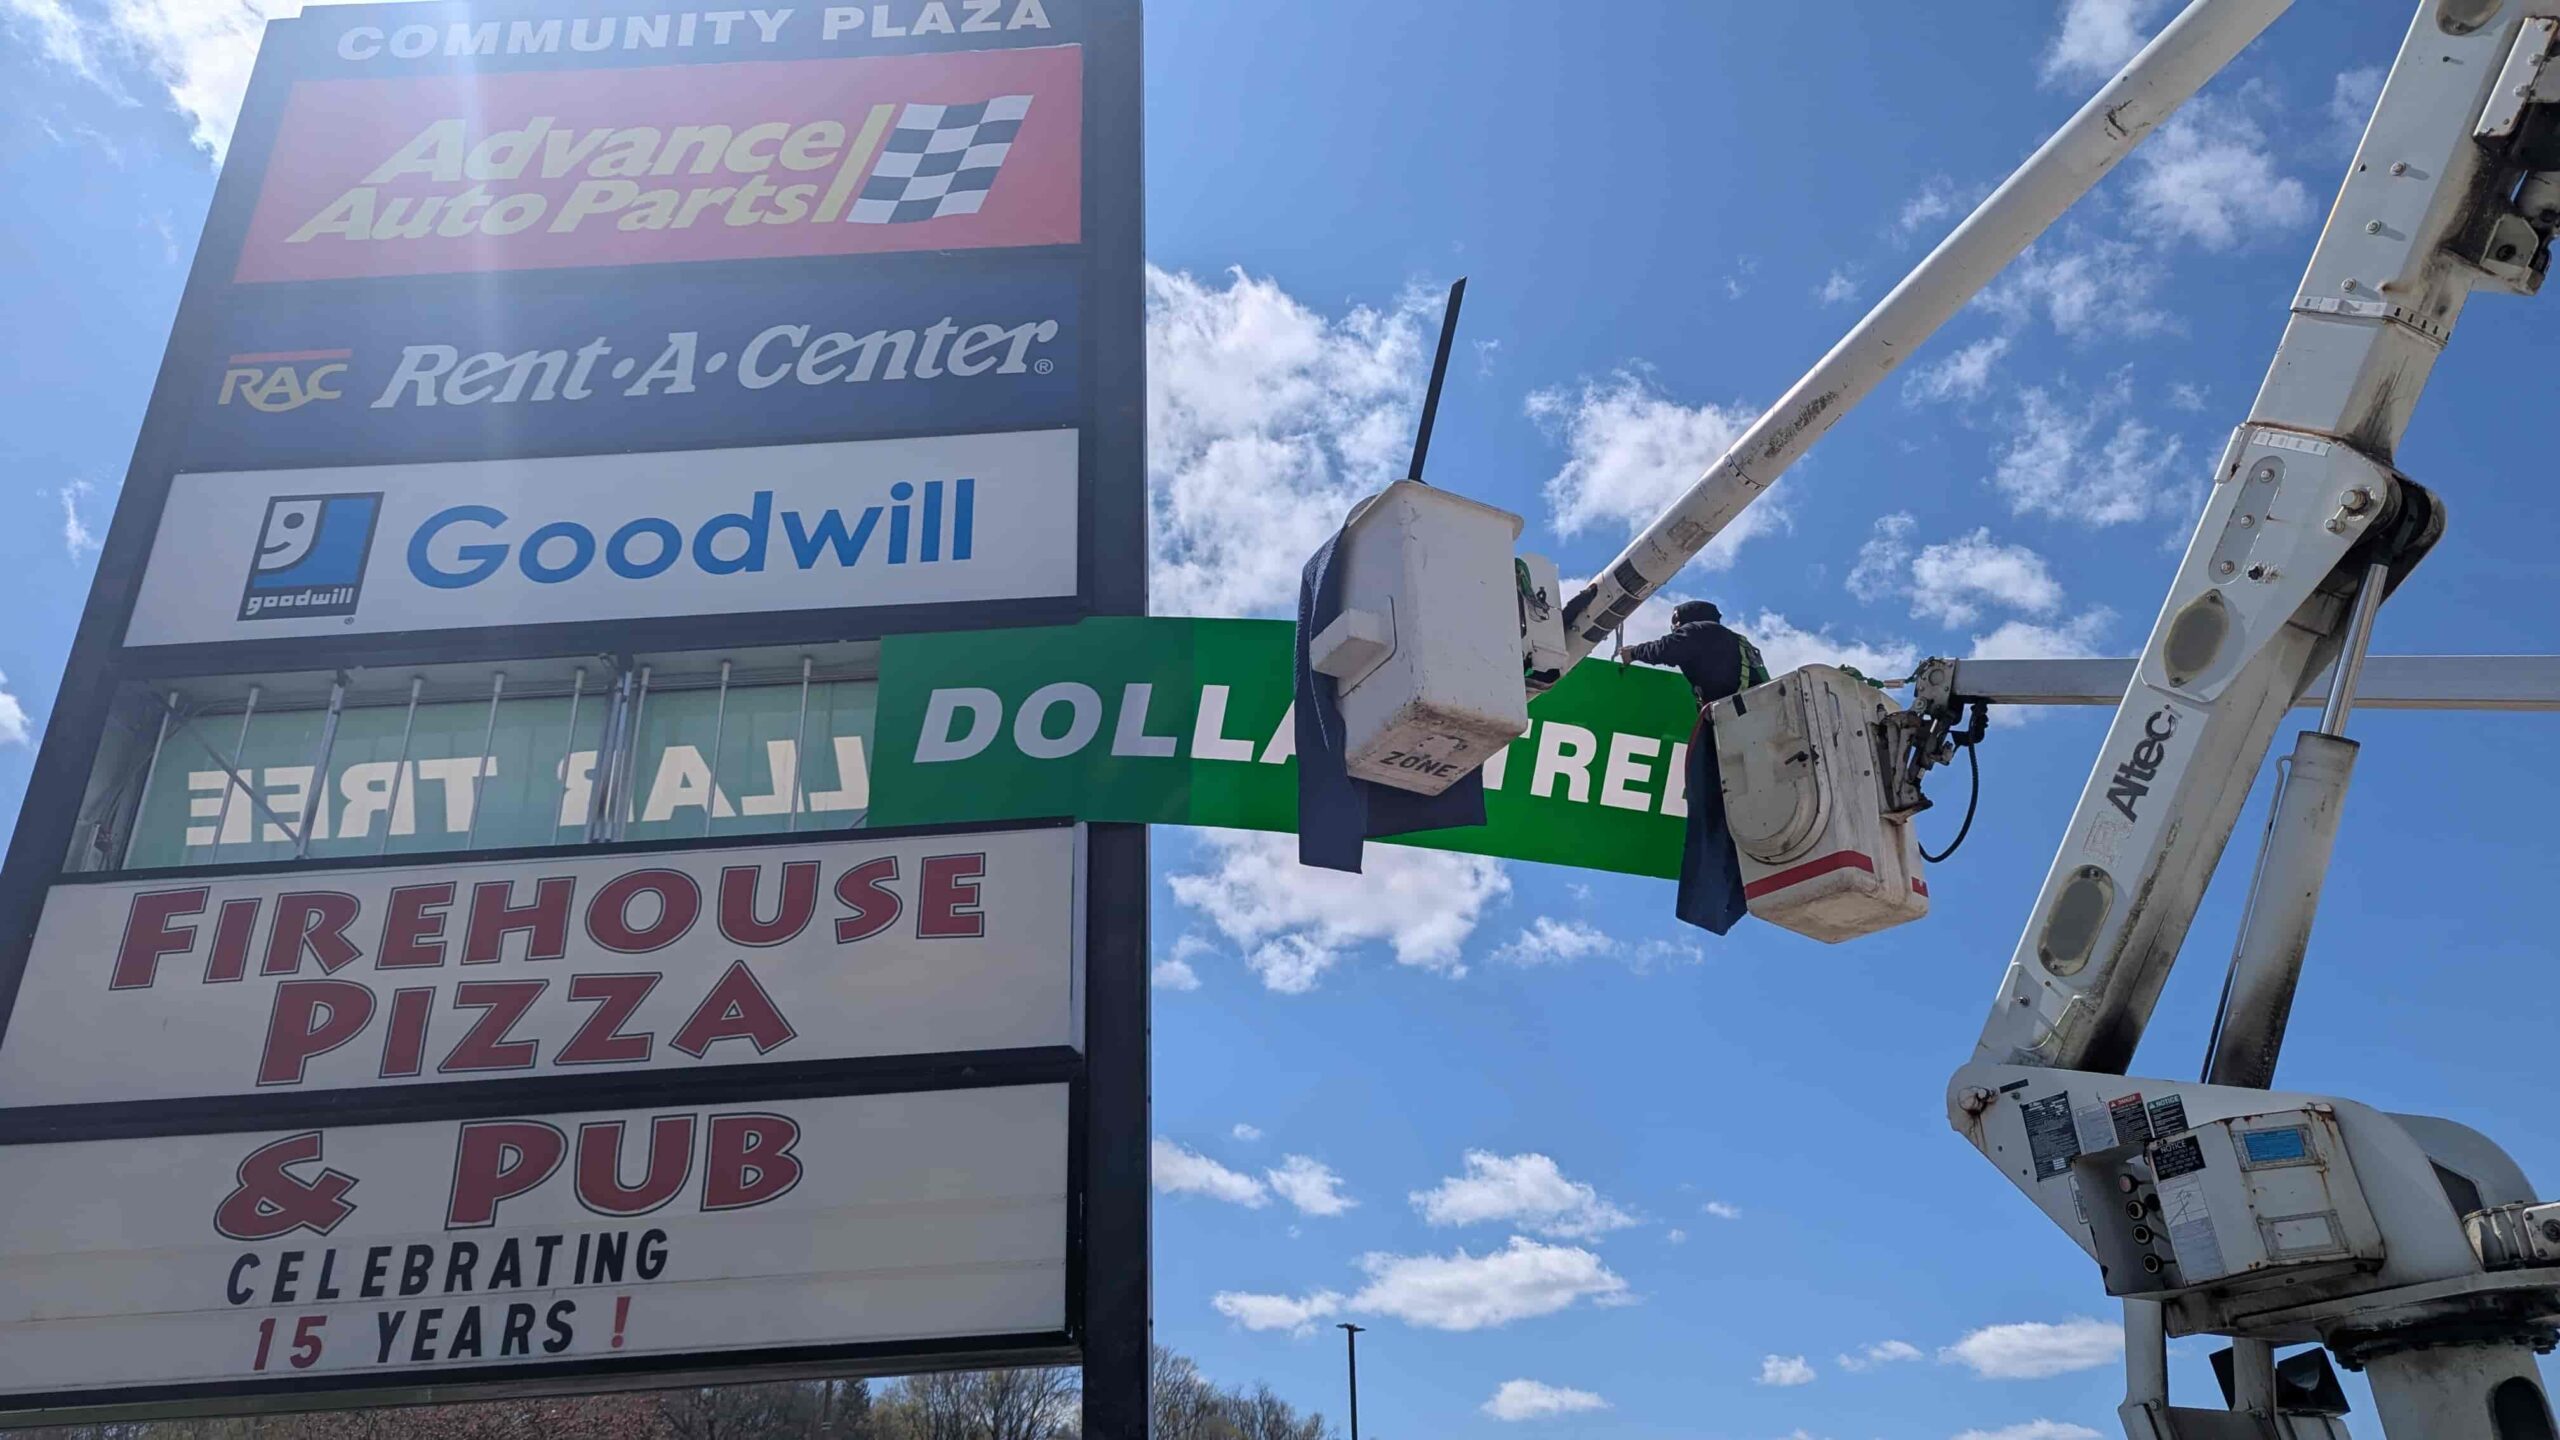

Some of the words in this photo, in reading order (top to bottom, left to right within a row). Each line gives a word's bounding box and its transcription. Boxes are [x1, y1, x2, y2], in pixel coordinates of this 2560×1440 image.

[337, 9, 795, 60] COMMUNITY
[822, 0, 1051, 40] PLAZA
[360, 117, 846, 184] Advance
[282, 184, 548, 243] Auto
[546, 174, 819, 233] Parts
[218, 363, 348, 412] RAC
[406, 477, 975, 590] Goodwill
[246, 587, 354, 616] goodwill
[1380, 750, 1458, 778] ZONE
[2106, 711, 2175, 823] Altec
[109, 851, 986, 991] FIREHOUSE
[256, 959, 797, 1088] PIZZA
[2155, 1095, 2179, 1108] NOTICE
[213, 1130, 358, 1242] &
[444, 1112, 804, 1231] PUB
[2160, 1140, 2186, 1153] NOTICE
[226, 1228, 669, 1306] CELEBRATING
[253, 1315, 328, 1372] 15
[375, 1299, 577, 1364] YEARS
